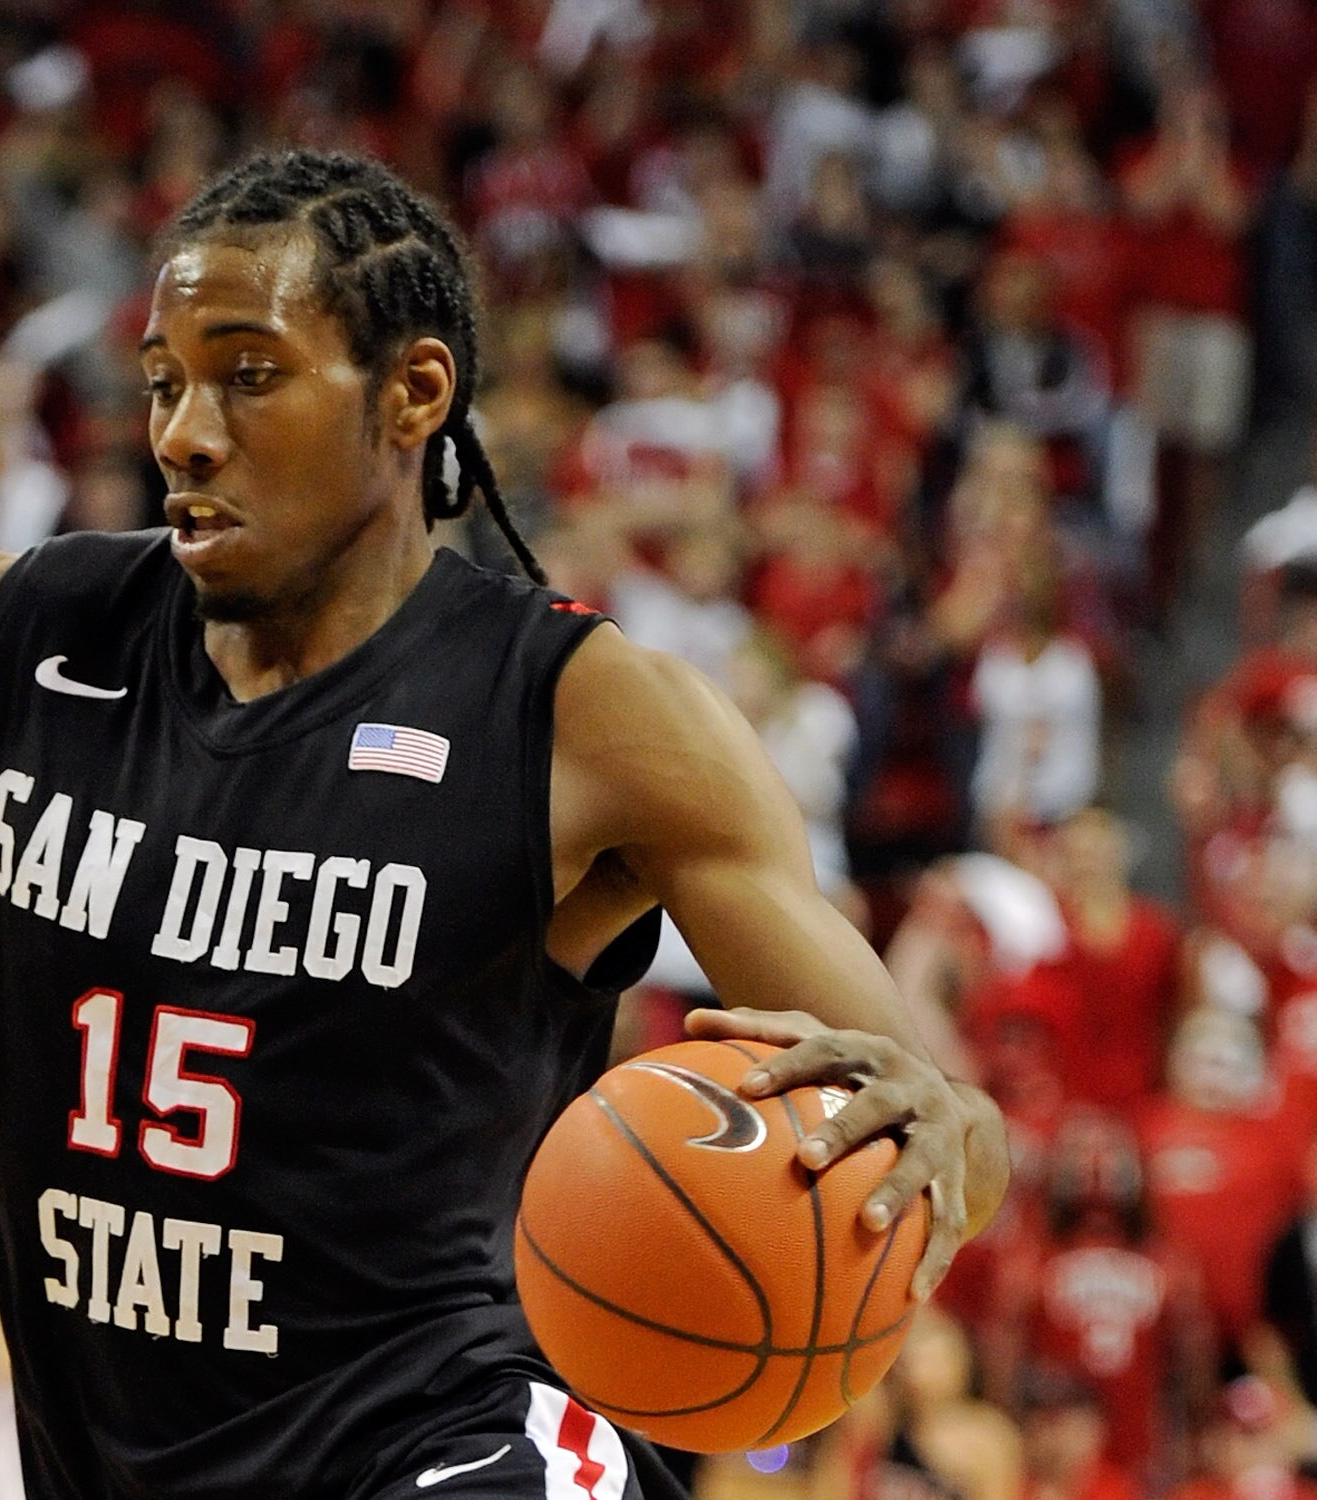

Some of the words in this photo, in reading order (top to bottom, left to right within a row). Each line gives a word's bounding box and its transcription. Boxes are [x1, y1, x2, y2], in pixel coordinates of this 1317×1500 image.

[151, 834, 427, 988] DIEGO
[67, 986, 256, 1181] 15
[37, 1188, 283, 1356] STATE
